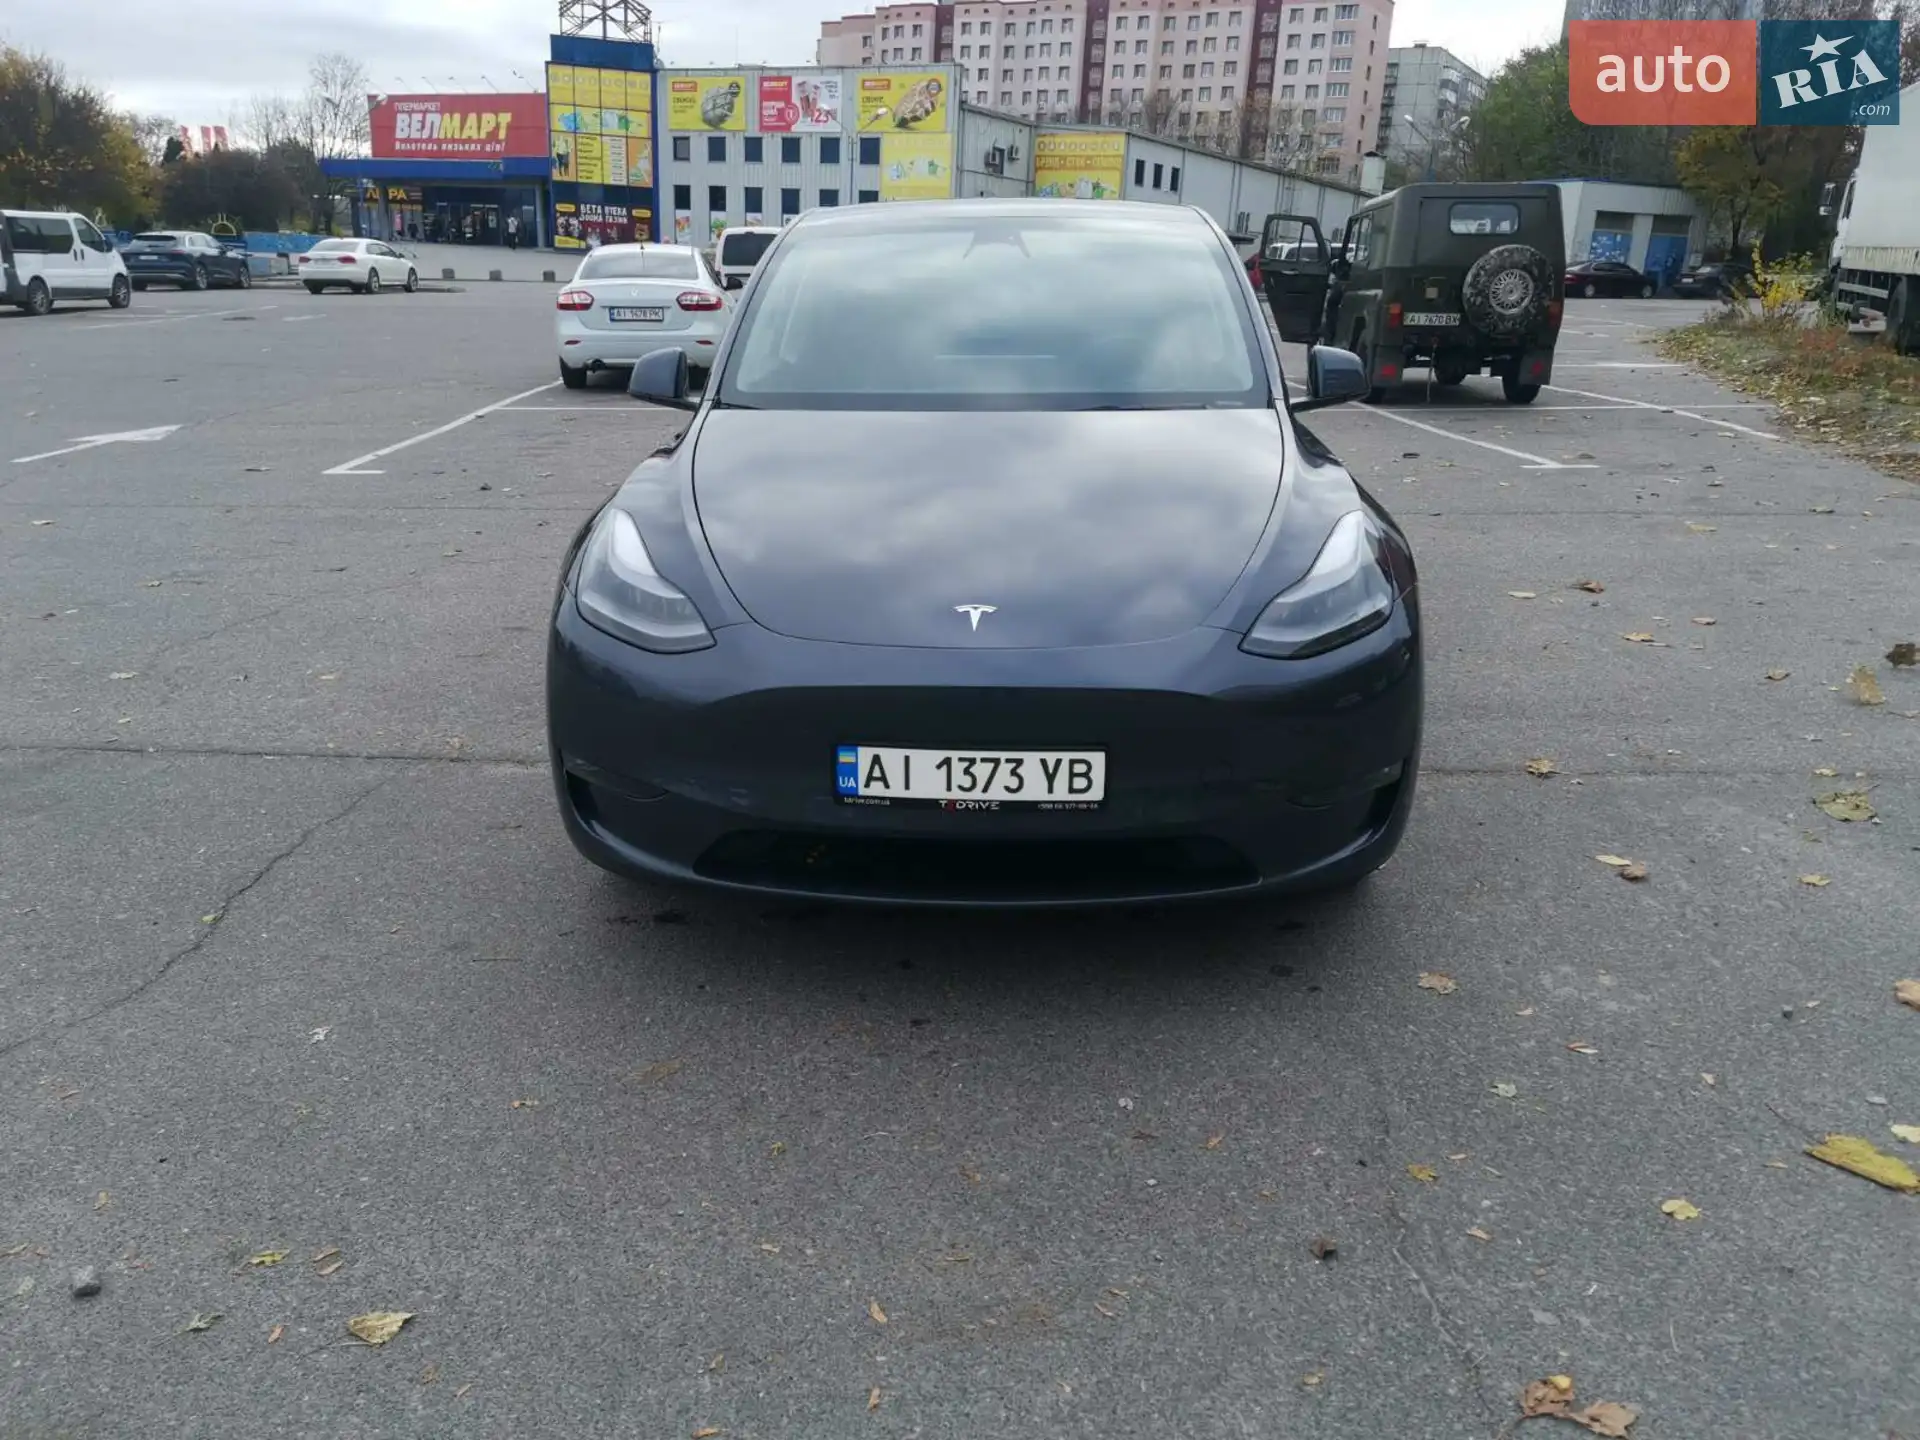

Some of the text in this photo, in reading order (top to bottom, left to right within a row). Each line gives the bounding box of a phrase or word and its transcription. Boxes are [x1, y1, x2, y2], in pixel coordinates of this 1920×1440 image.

[395, 112, 512, 140] ВЕЛМАРТ
[839, 753, 1093, 795] UA AI 1373 YB
